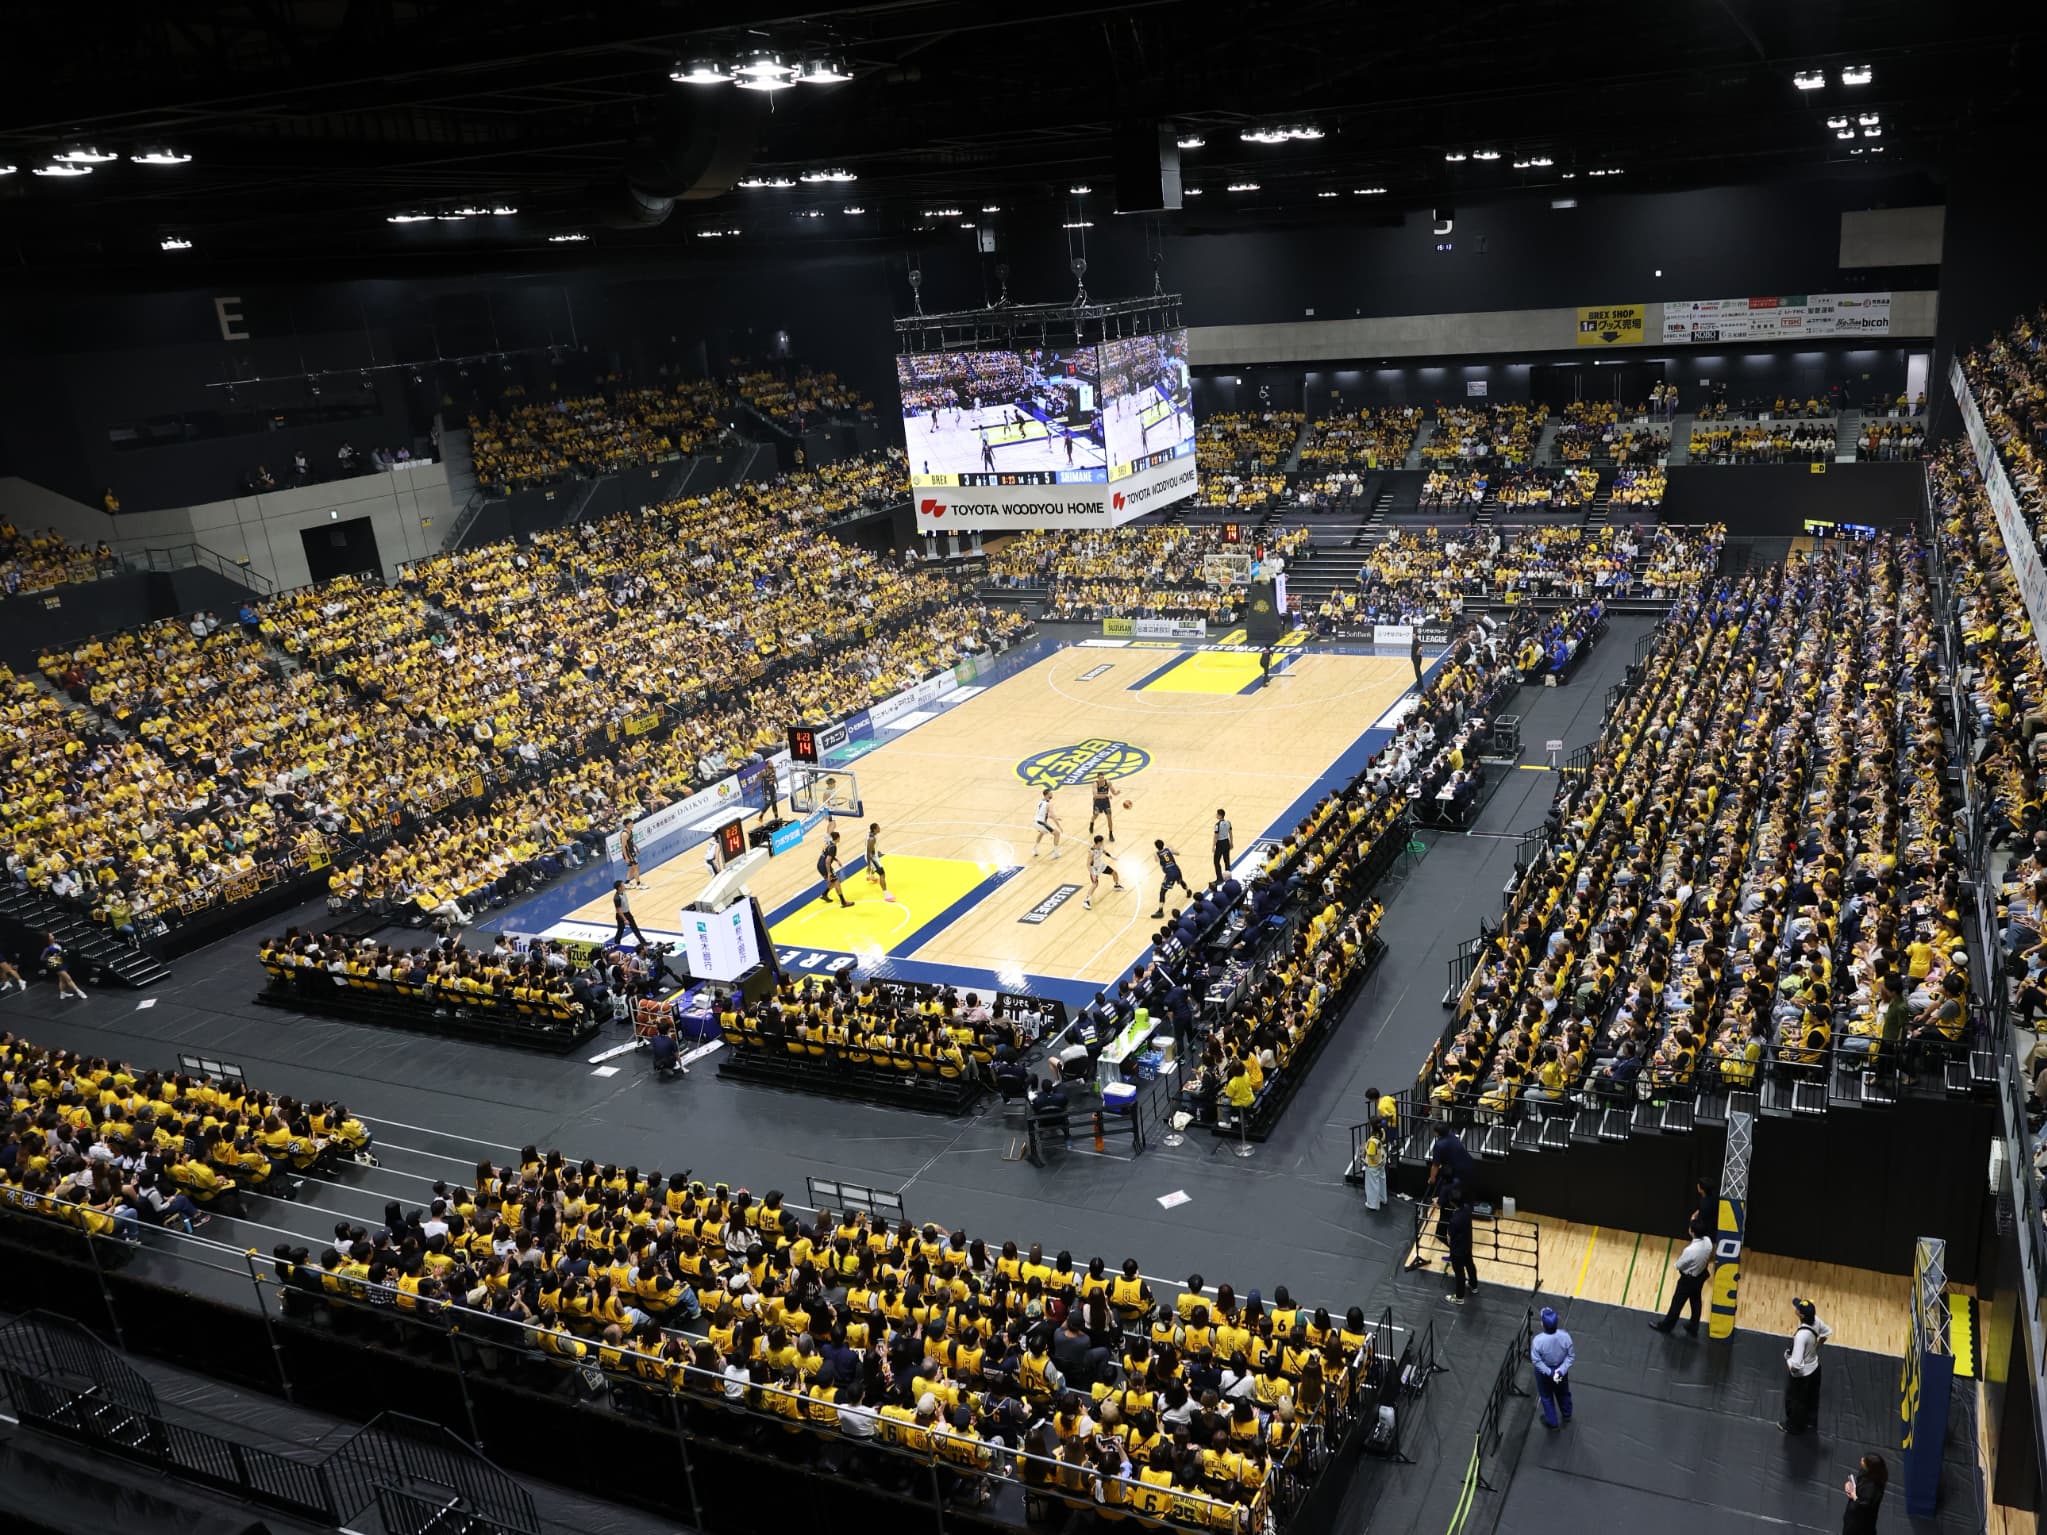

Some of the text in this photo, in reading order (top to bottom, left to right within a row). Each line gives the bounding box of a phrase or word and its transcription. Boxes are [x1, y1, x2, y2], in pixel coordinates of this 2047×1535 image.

[214, 296, 250, 341] E
[1588, 309, 1634, 320] BREX SHOP
[1582, 321, 1595, 331] 1F
[964, 474, 970, 486] 3
[1044, 472, 1050, 484] 5
[1126, 469, 1195, 505] TOYOTA WOODYOU HOME
[951, 502, 1105, 516] TOYOTA WOODYOU HOME
[799, 742, 811, 755] 14
[1064, 743, 1125, 785] UTSUNOMIYA
[729, 837, 740, 852] 14
[762, 1215, 775, 1229] 42
[1278, 1319, 1286, 1332] 6
[1260, 1349, 1269, 1365] 6
[915, 1431, 923, 1448] 6
[1144, 1494, 1157, 1511] 6
